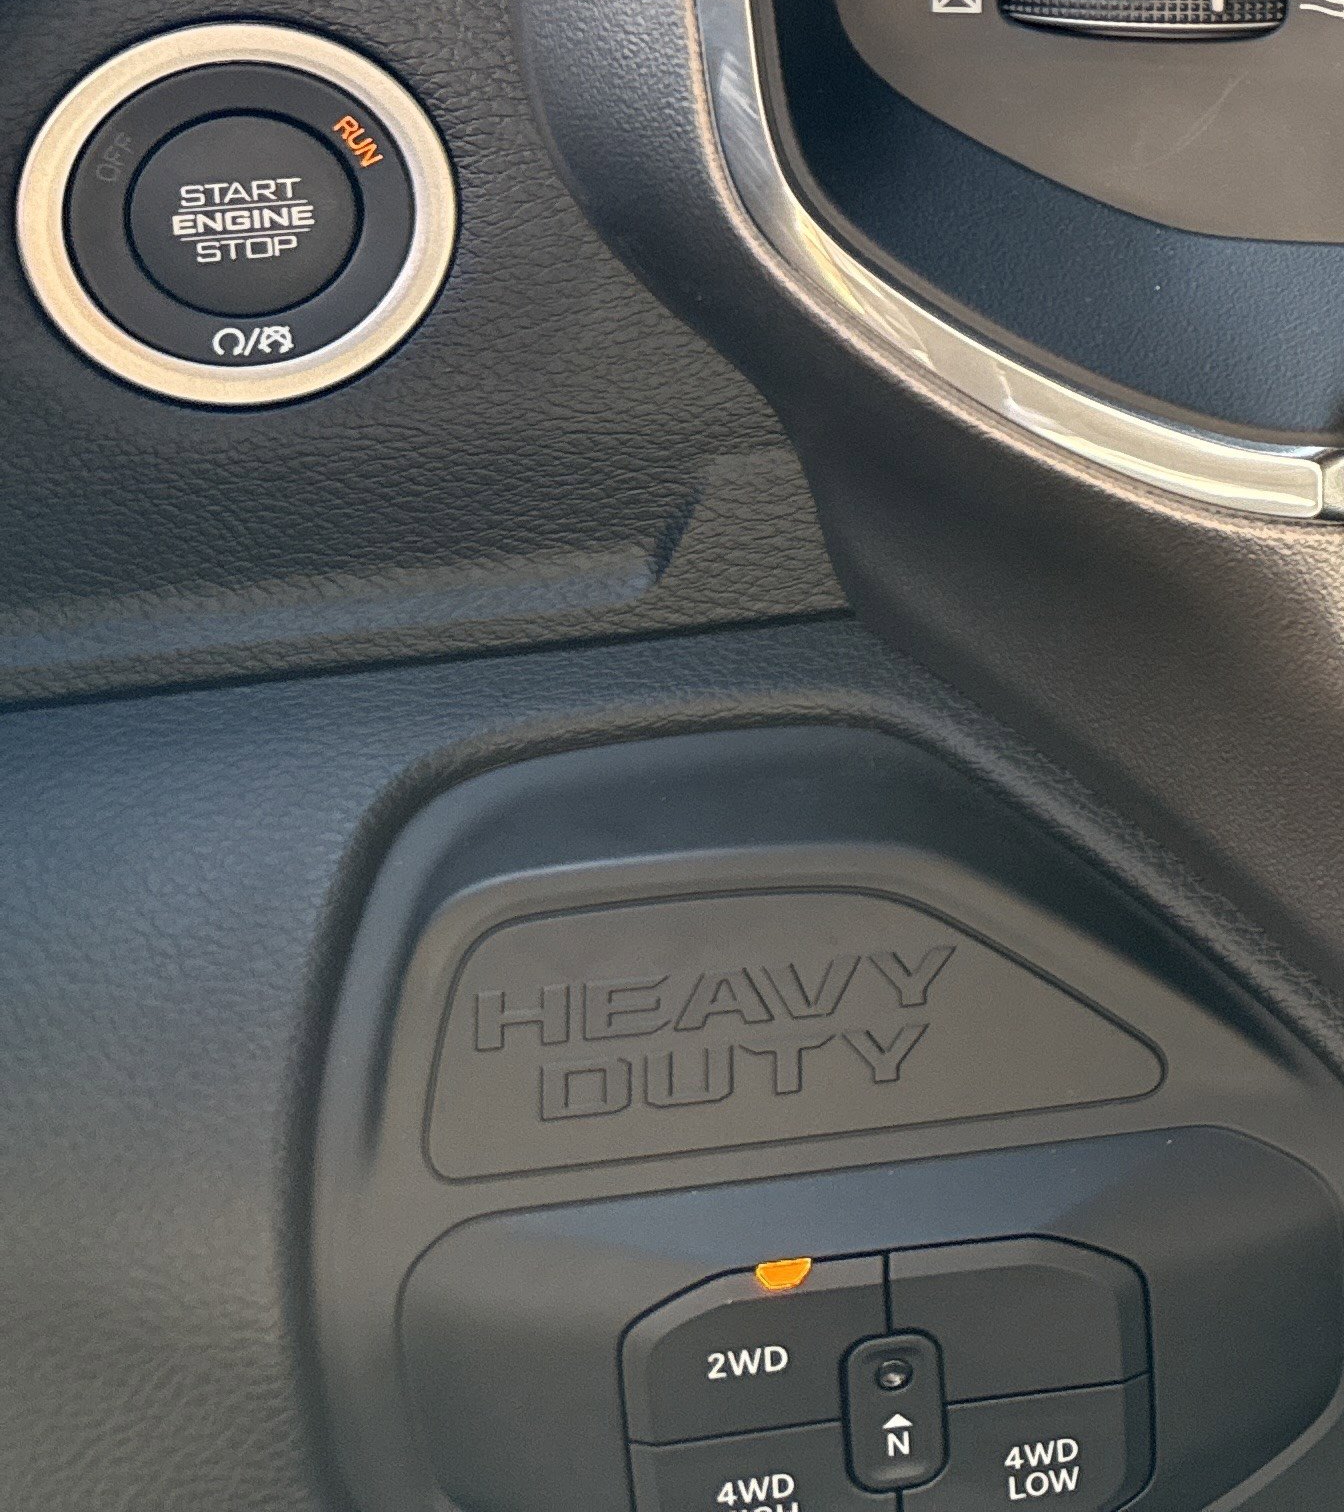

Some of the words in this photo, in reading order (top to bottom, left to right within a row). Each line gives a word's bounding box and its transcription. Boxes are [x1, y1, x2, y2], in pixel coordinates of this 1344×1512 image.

[332, 115, 383, 168] RUN
[180, 178, 302, 207] START
[172, 205, 315, 236] ENGINE
[197, 235, 298, 263] STOP
[474, 945, 957, 1052] HEAVY
[538, 1022, 931, 1123] DUTY
[706, 1345, 789, 1380] 2WD
[886, 1430, 911, 1458] N
[1004, 1437, 1080, 1472] 4WD
[717, 1472, 796, 1508] 4WD
[1007, 1466, 1081, 1501] LOW
